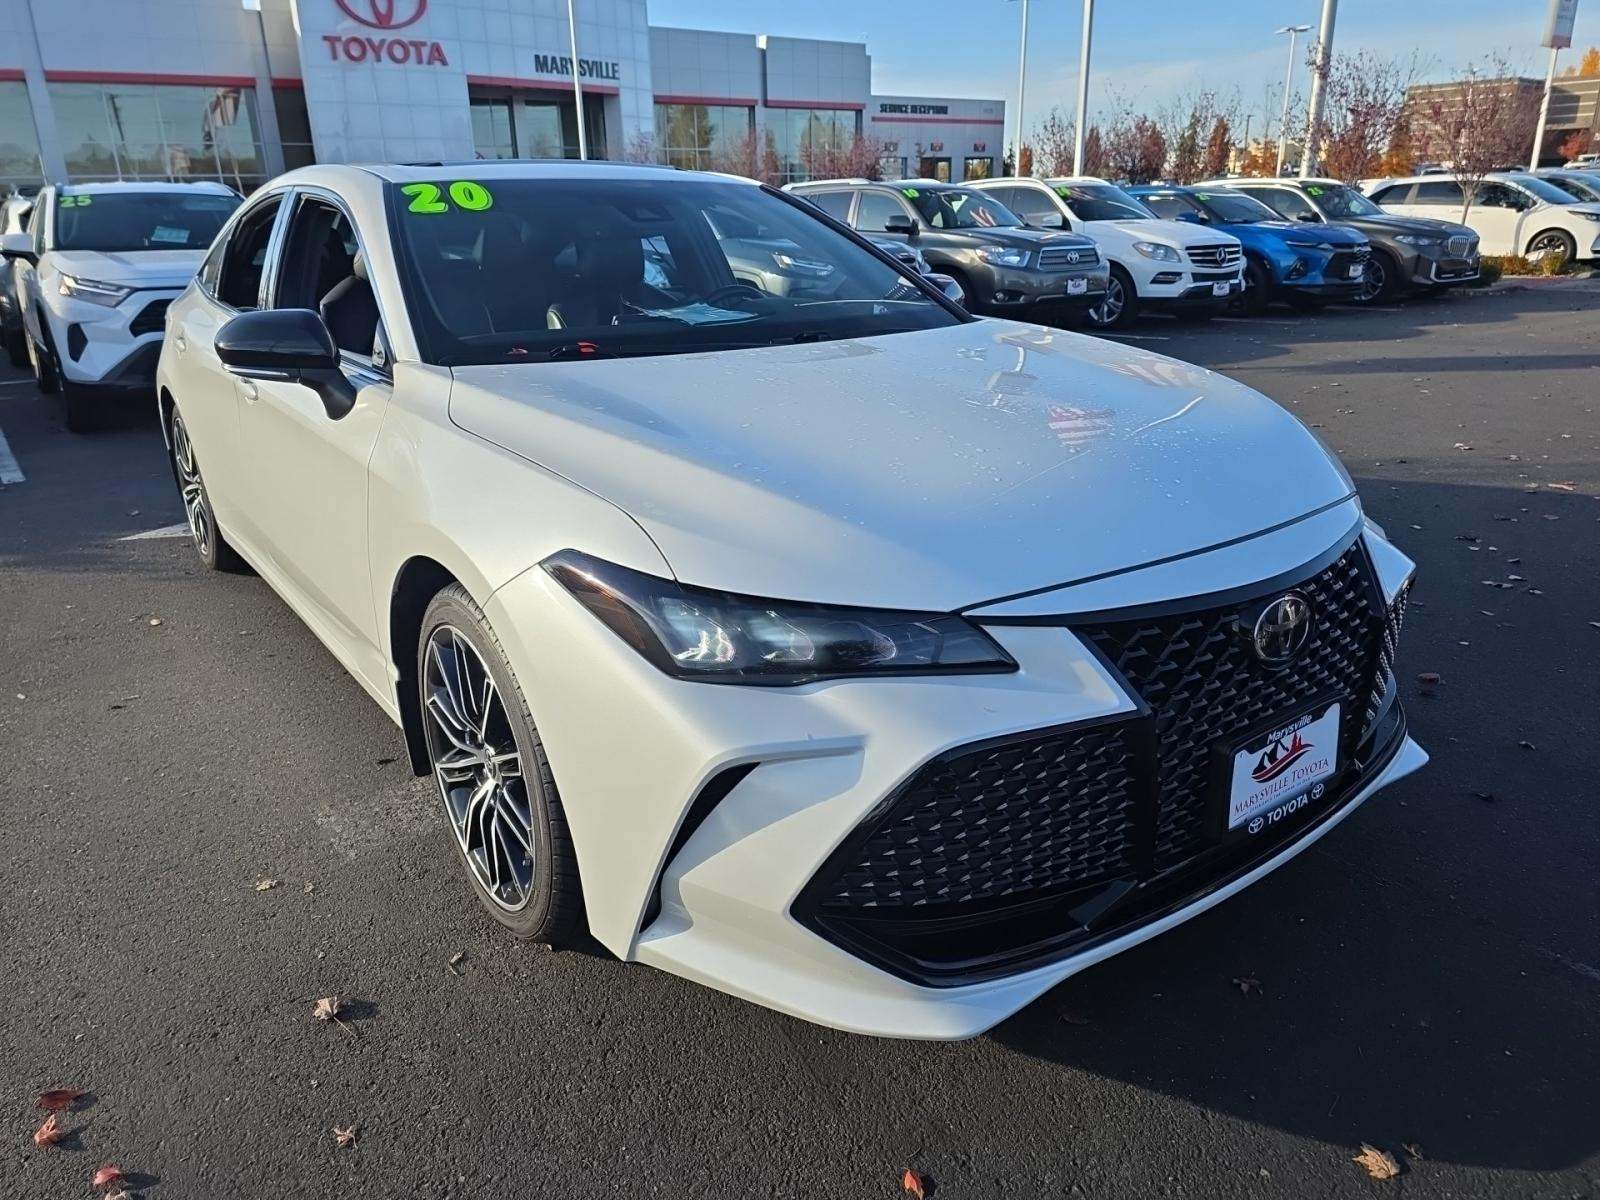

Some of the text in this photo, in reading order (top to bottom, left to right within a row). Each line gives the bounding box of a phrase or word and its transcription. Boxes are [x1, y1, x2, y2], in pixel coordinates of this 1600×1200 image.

[322, 35, 449, 66] TOYOTA
[534, 54, 620, 80] MARYSVILLE
[59, 194, 92, 208] 25
[401, 181, 494, 213] 20
[1266, 714, 1313, 745] Marysville
[1234, 777, 1288, 816] MARYSVILLE
[1292, 759, 1329, 782] TOYOTA
[1267, 793, 1309, 825] TOYOTA
